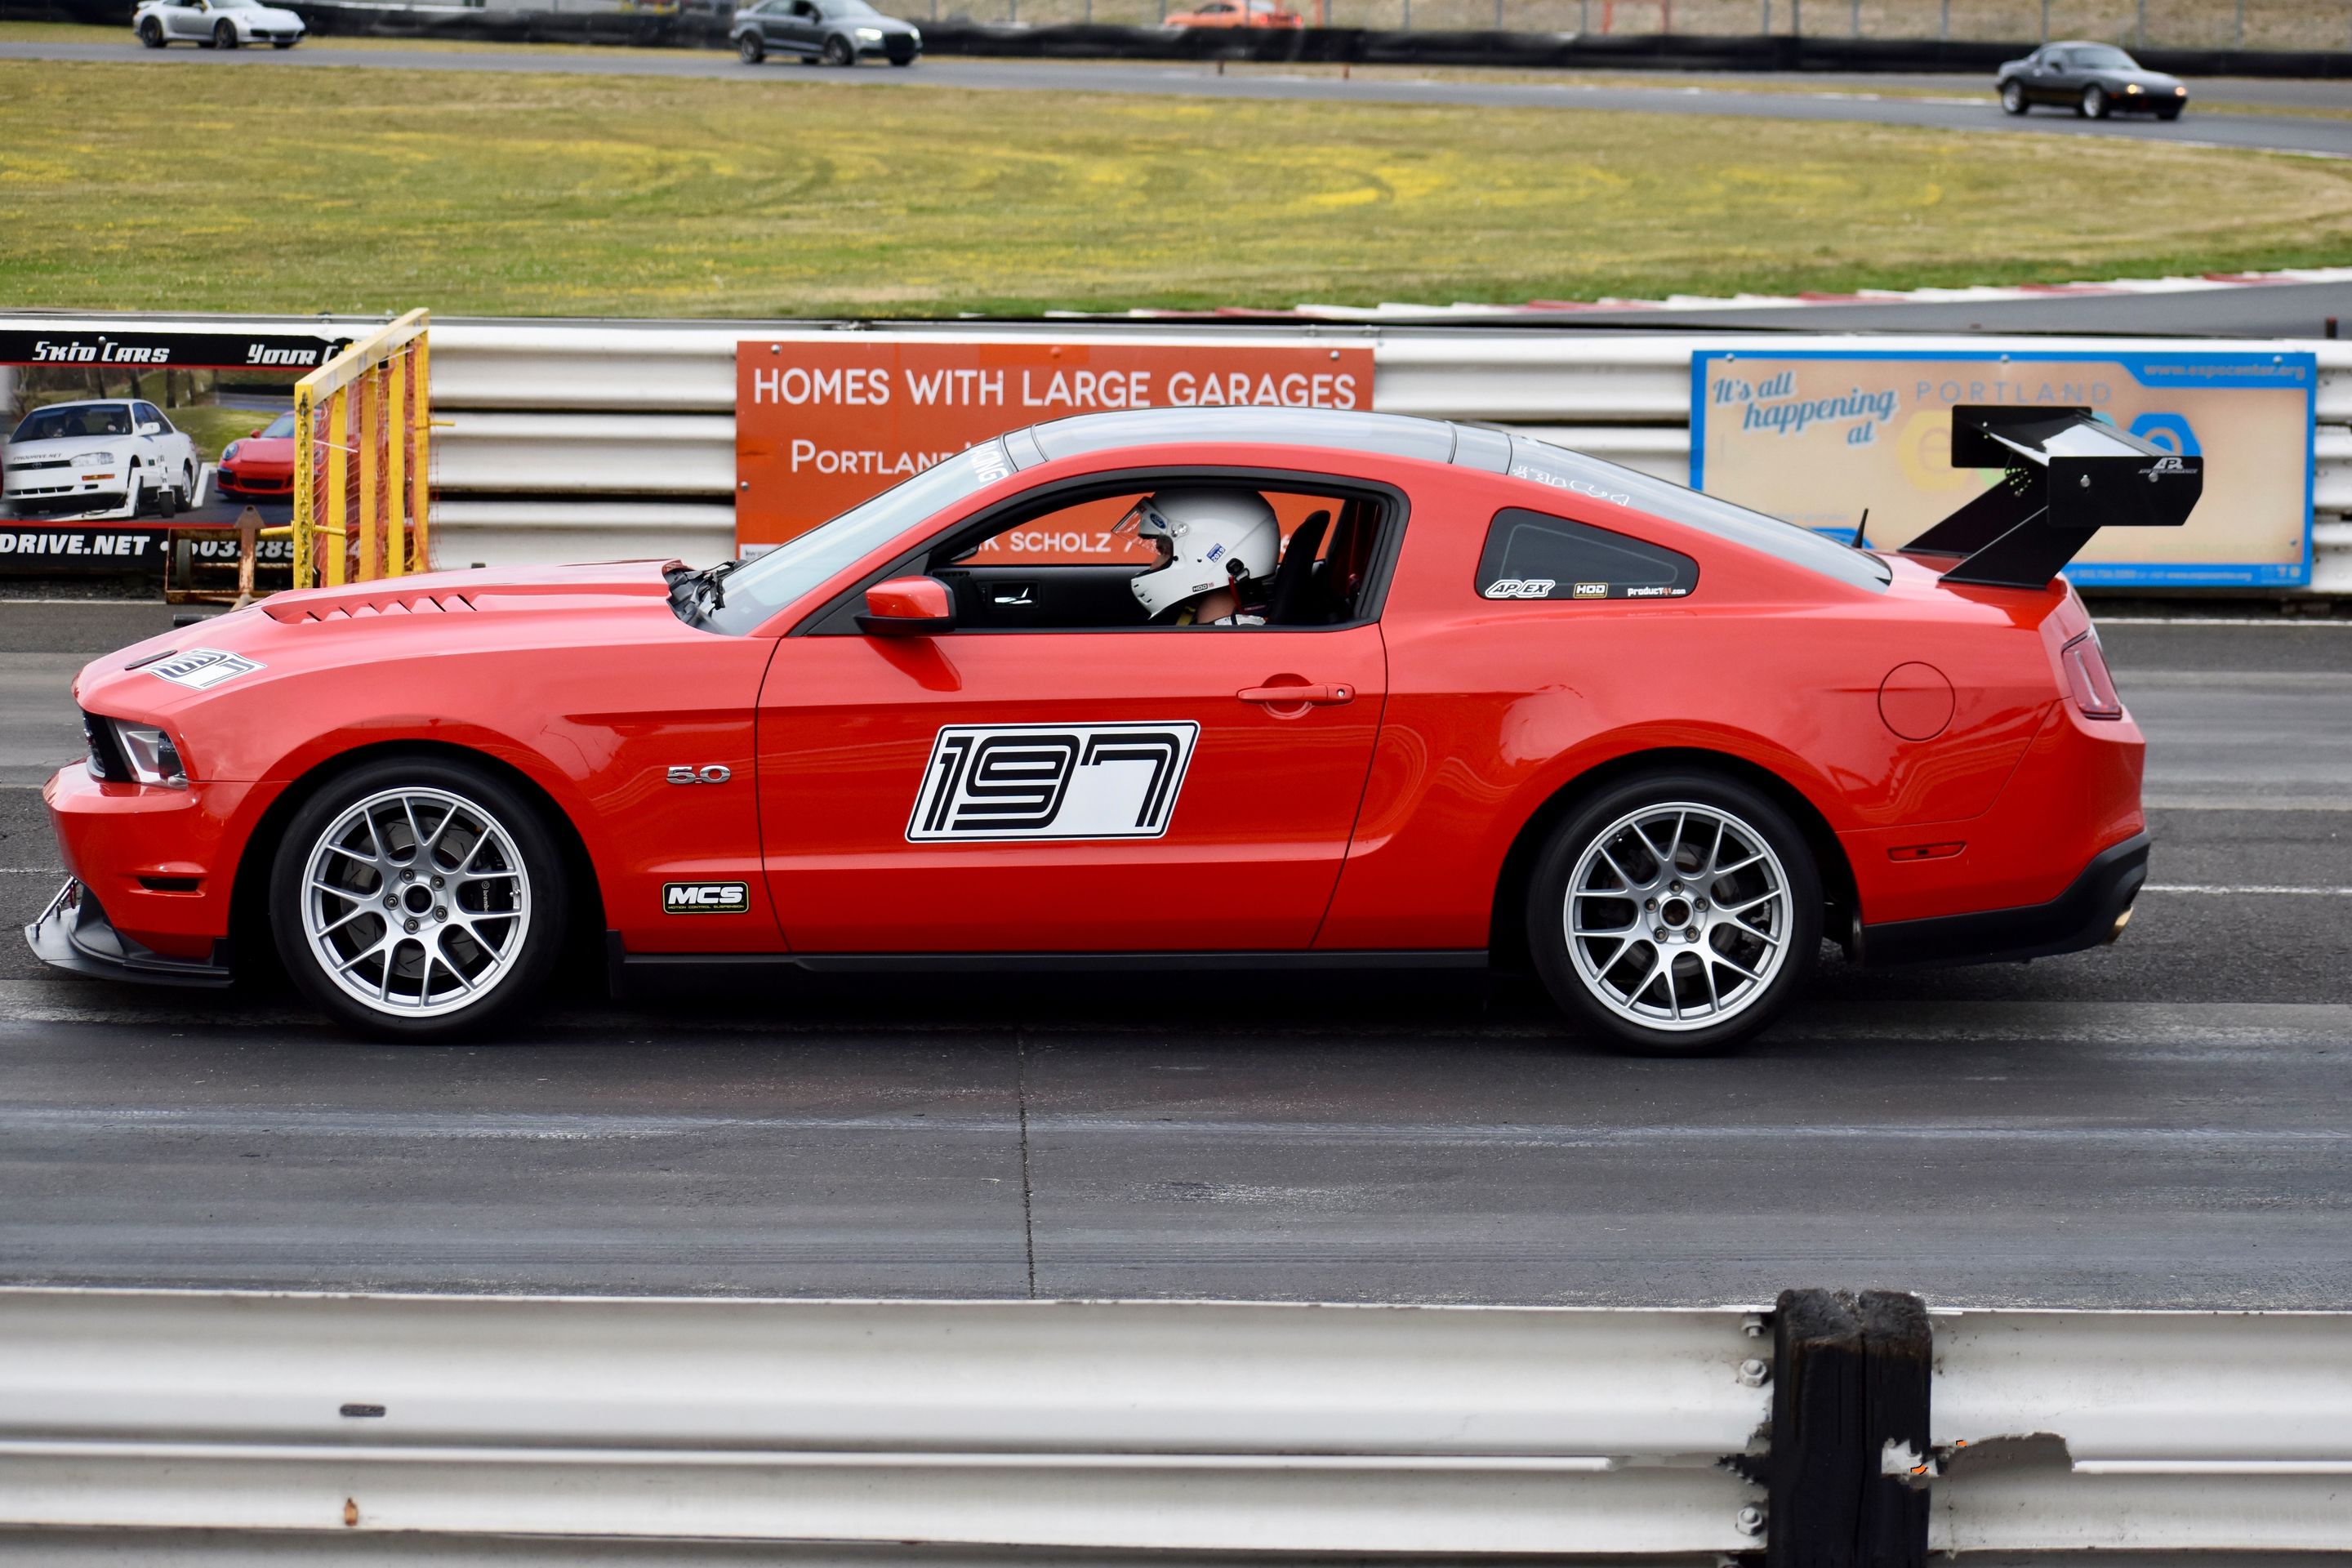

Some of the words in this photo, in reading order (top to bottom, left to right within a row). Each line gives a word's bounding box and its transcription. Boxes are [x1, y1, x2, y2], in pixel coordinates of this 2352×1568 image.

[754, 368, 890, 405] HOMES
[905, 370, 1004, 406] WITH
[1022, 370, 1152, 408] LARGE
[1168, 371, 1356, 409] GARAGES
[1713, 378, 1751, 403] It's
[1757, 371, 1793, 398] all
[1916, 381, 2111, 405] PORTLAND
[1743, 388, 1895, 434] happening
[1846, 421, 1873, 445] at
[791, 439, 954, 474] PORTLAN
[1009, 532, 1111, 553] SCHOLZ
[666, 764, 731, 784] 5.0
[921, 733, 1181, 831] 197
[668, 886, 744, 905] MCS
